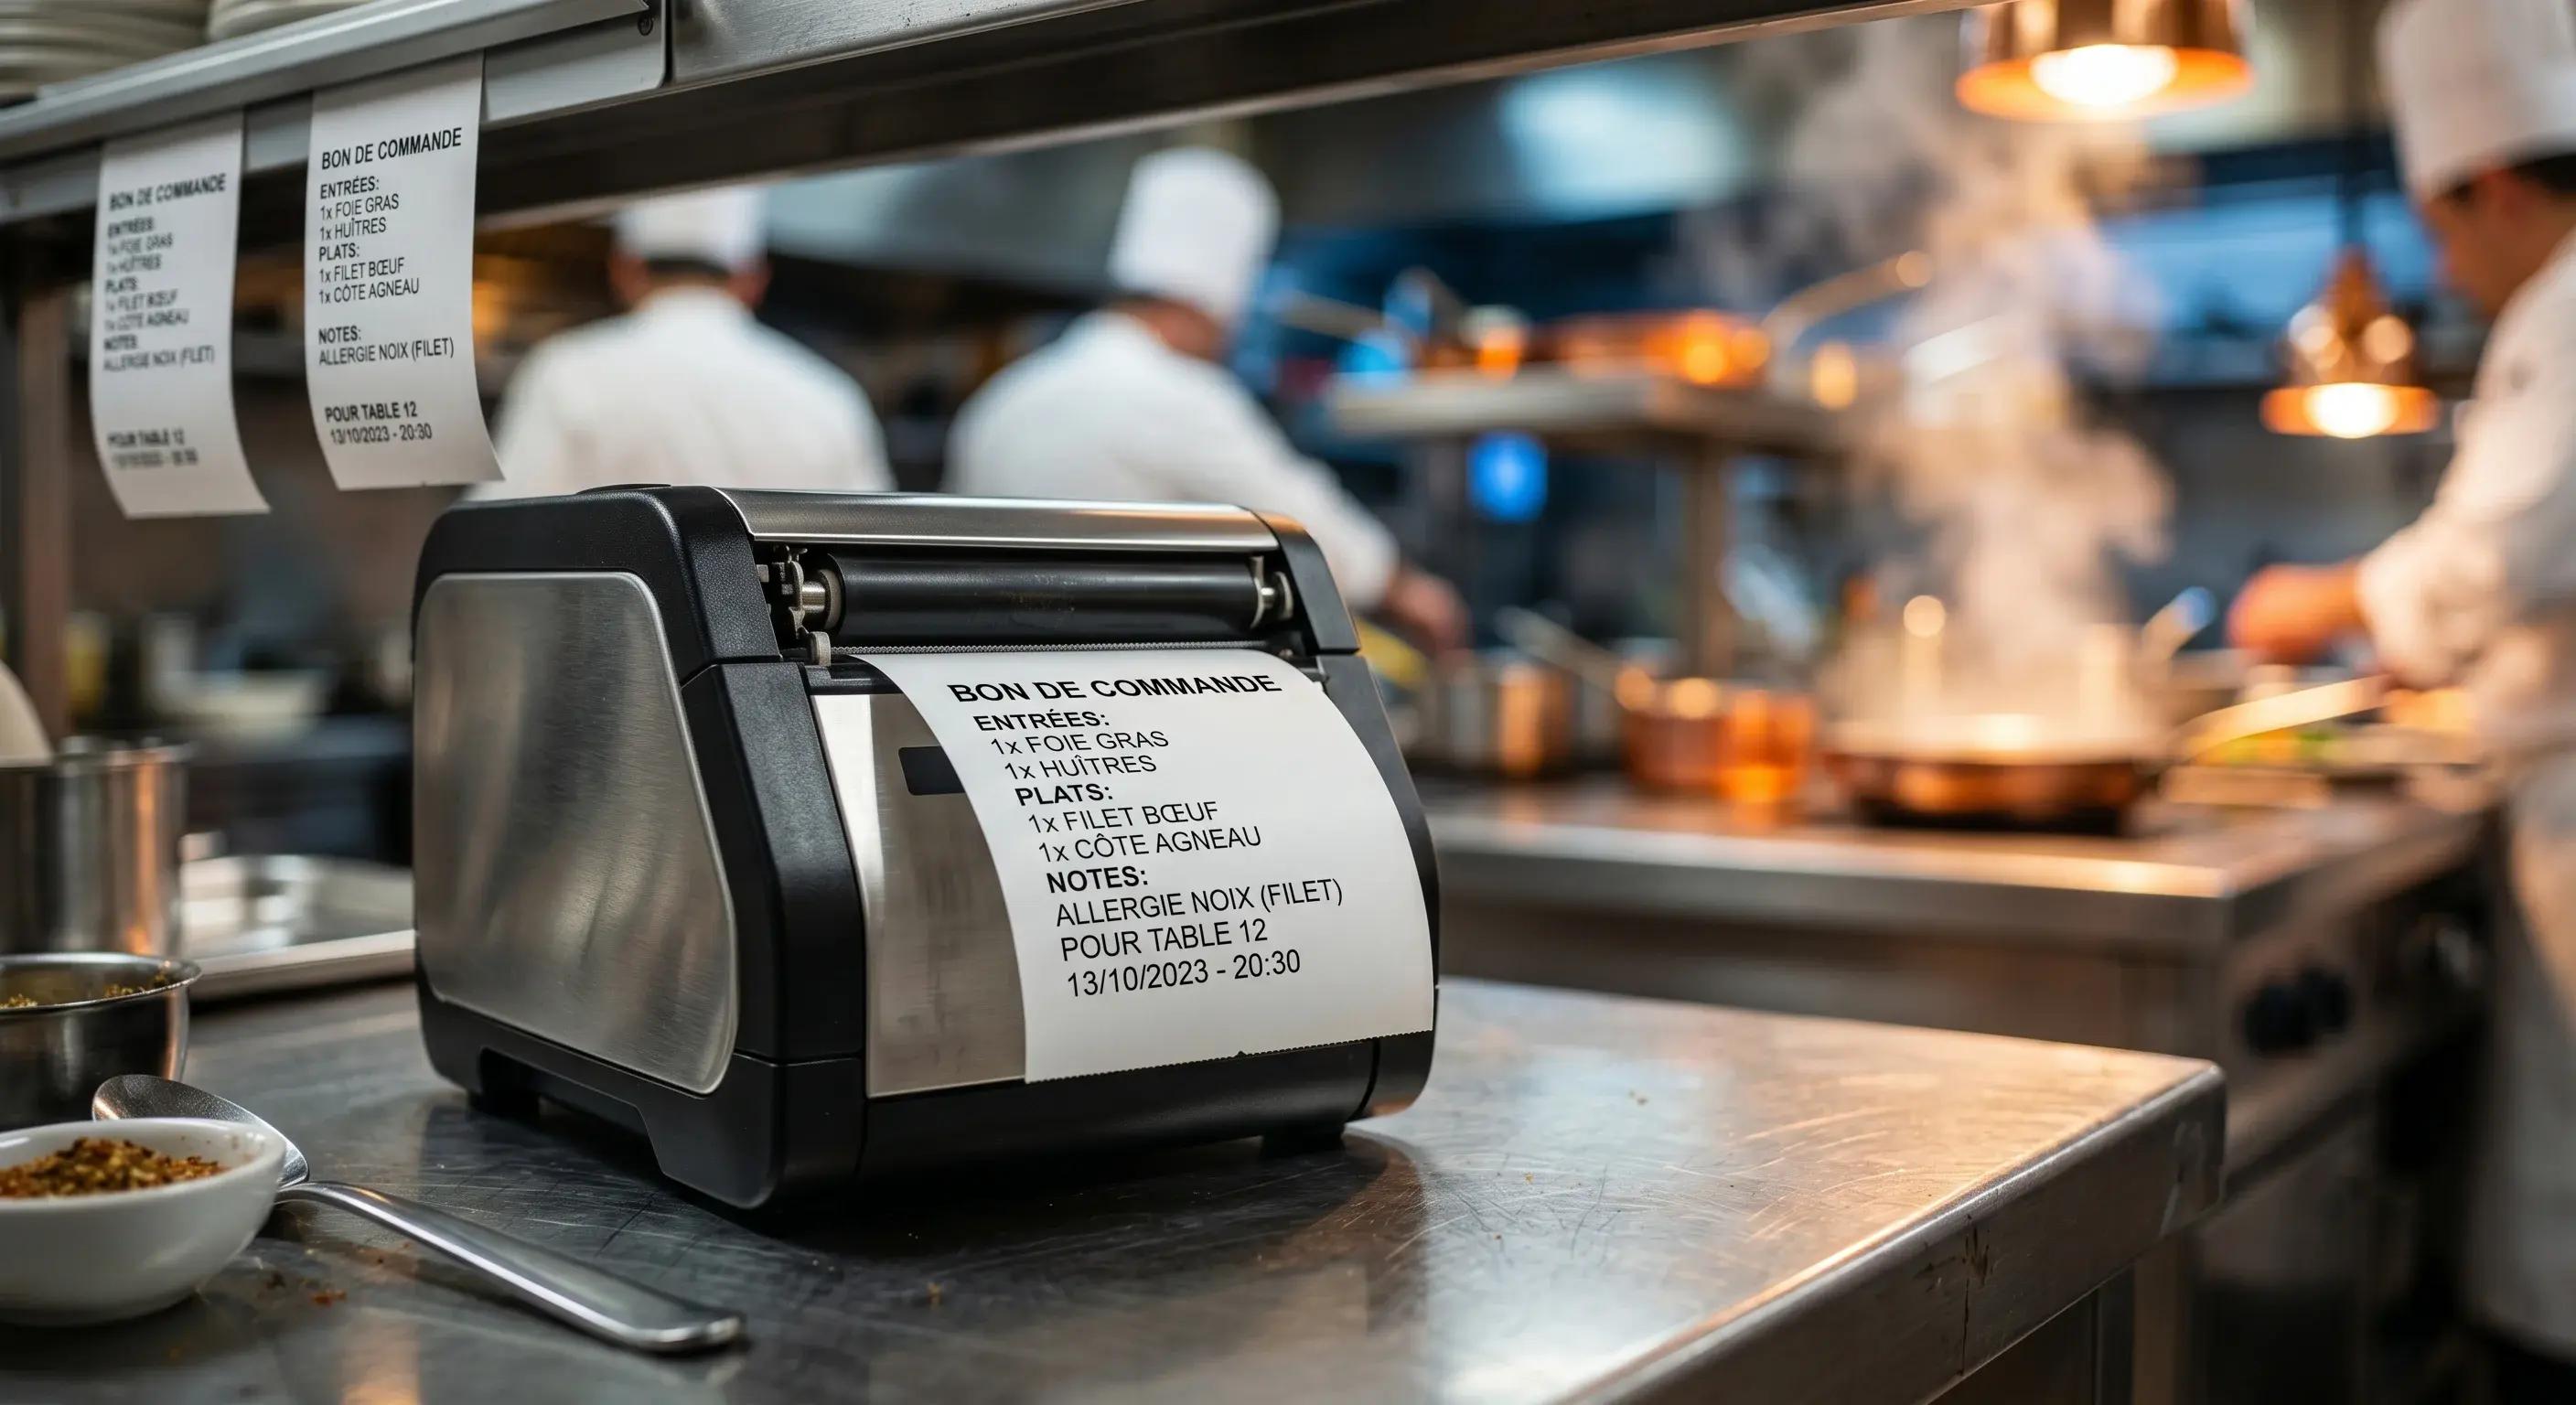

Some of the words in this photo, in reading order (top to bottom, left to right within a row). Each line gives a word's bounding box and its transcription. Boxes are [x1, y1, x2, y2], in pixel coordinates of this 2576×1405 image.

[322, 147, 351, 170] BON
[355, 144, 374, 164] DE
[378, 127, 462, 160] COMMANDE
[156, 172, 227, 202] COMMANDE
[320, 176, 380, 199] ENTRÉES:
[320, 205, 332, 220] 1x
[335, 198, 362, 219] FOIE
[366, 193, 399, 213] GRAS
[320, 226, 332, 241] 1x
[335, 216, 387, 240] HUÎTRES
[319, 242, 360, 262] PLATS:
[319, 268, 331, 284] 1x
[334, 263, 366, 282] FILET
[369, 257, 405, 278] BŒUF
[319, 290, 331, 305] 1x
[334, 284, 366, 304] CÔTE
[369, 277, 420, 299] AGNEAU
[318, 325, 362, 345] NOTES:
[319, 345, 376, 366] ALLERGIE
[379, 342, 409, 360] NOIX
[412, 337, 455, 361] (FILET)
[325, 404, 360, 424] POUR
[360, 402, 402, 421] TABLE
[403, 401, 418, 418] 12
[330, 425, 391, 445] 13/10/2023
[399, 423, 433, 441] 20:30
[947, 683, 1032, 702] BON
[1034, 681, 1088, 700] DE
[1089, 674, 1283, 697] COMMANDE
[972, 708, 1110, 731] ENTRÉES:
[991, 737, 1023, 756] 1x
[1025, 734, 1092, 754] FOIE
[1096, 730, 1170, 748] GRAS
[1004, 762, 1036, 780] 1x
[1038, 754, 1157, 778] HUÎTRES
[1014, 783, 1113, 807] PLATS:
[1028, 813, 1059, 834] 1x
[1062, 807, 1133, 831] FILET
[1142, 800, 1218, 825] BŒUF
[1038, 841, 1069, 863] 1x
[1074, 832, 1150, 859] CÔTE
[1155, 825, 1262, 854] AGNEAU
[1046, 864, 1149, 895] NOTES:
[1056, 892, 1186, 928] ALLERGIE
[1190, 885, 1256, 915] NOIX
[1260, 877, 1344, 914] (FILET)
[1060, 929, 1143, 962] POUR
[1146, 920, 1233, 953] TABLE
[1238, 917, 1269, 944] 12
[1067, 958, 1209, 998] 13/10/2023
[1232, 948, 1302, 981] 20:30
